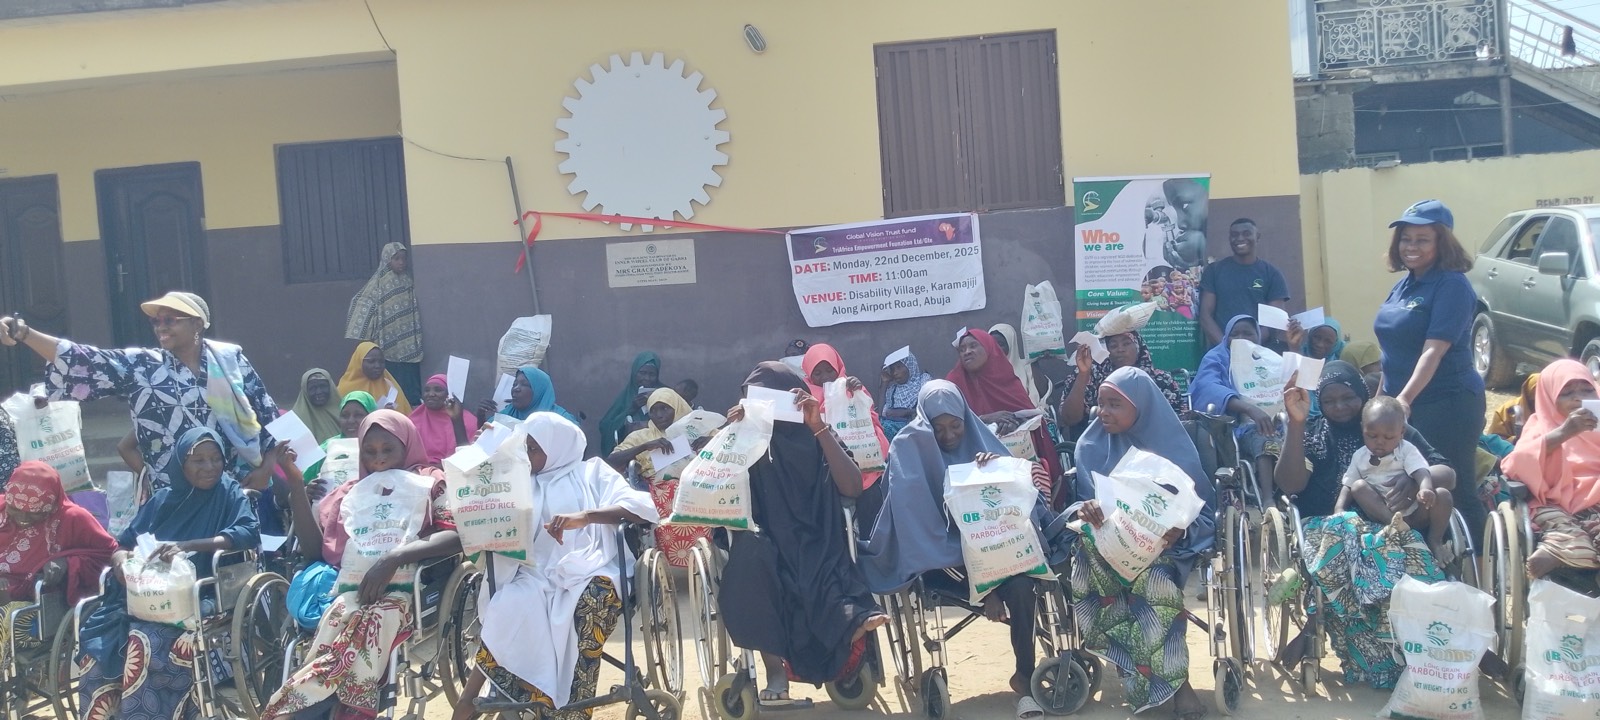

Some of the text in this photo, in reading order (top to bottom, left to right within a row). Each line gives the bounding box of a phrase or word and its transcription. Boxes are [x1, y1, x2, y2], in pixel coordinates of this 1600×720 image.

[846, 232, 865, 240] Global
[1082, 230, 1120, 243] Who
[854, 242, 888, 251] Empowerment
[794, 246, 979, 274] DATE: Monday, 22nd December, 2025
[848, 269, 928, 284] TIME: 11:00am
[803, 277, 977, 304] VENUE: Disability Village, Karamajiji
[832, 295, 950, 315] Along Airport Road, Abuja
[458, 503, 495, 514] PARBOILED
[1016, 534, 1024, 542] KG
[1404, 641, 1476, 662] QB-FOODS
[1408, 665, 1454, 680] PARBOILED
